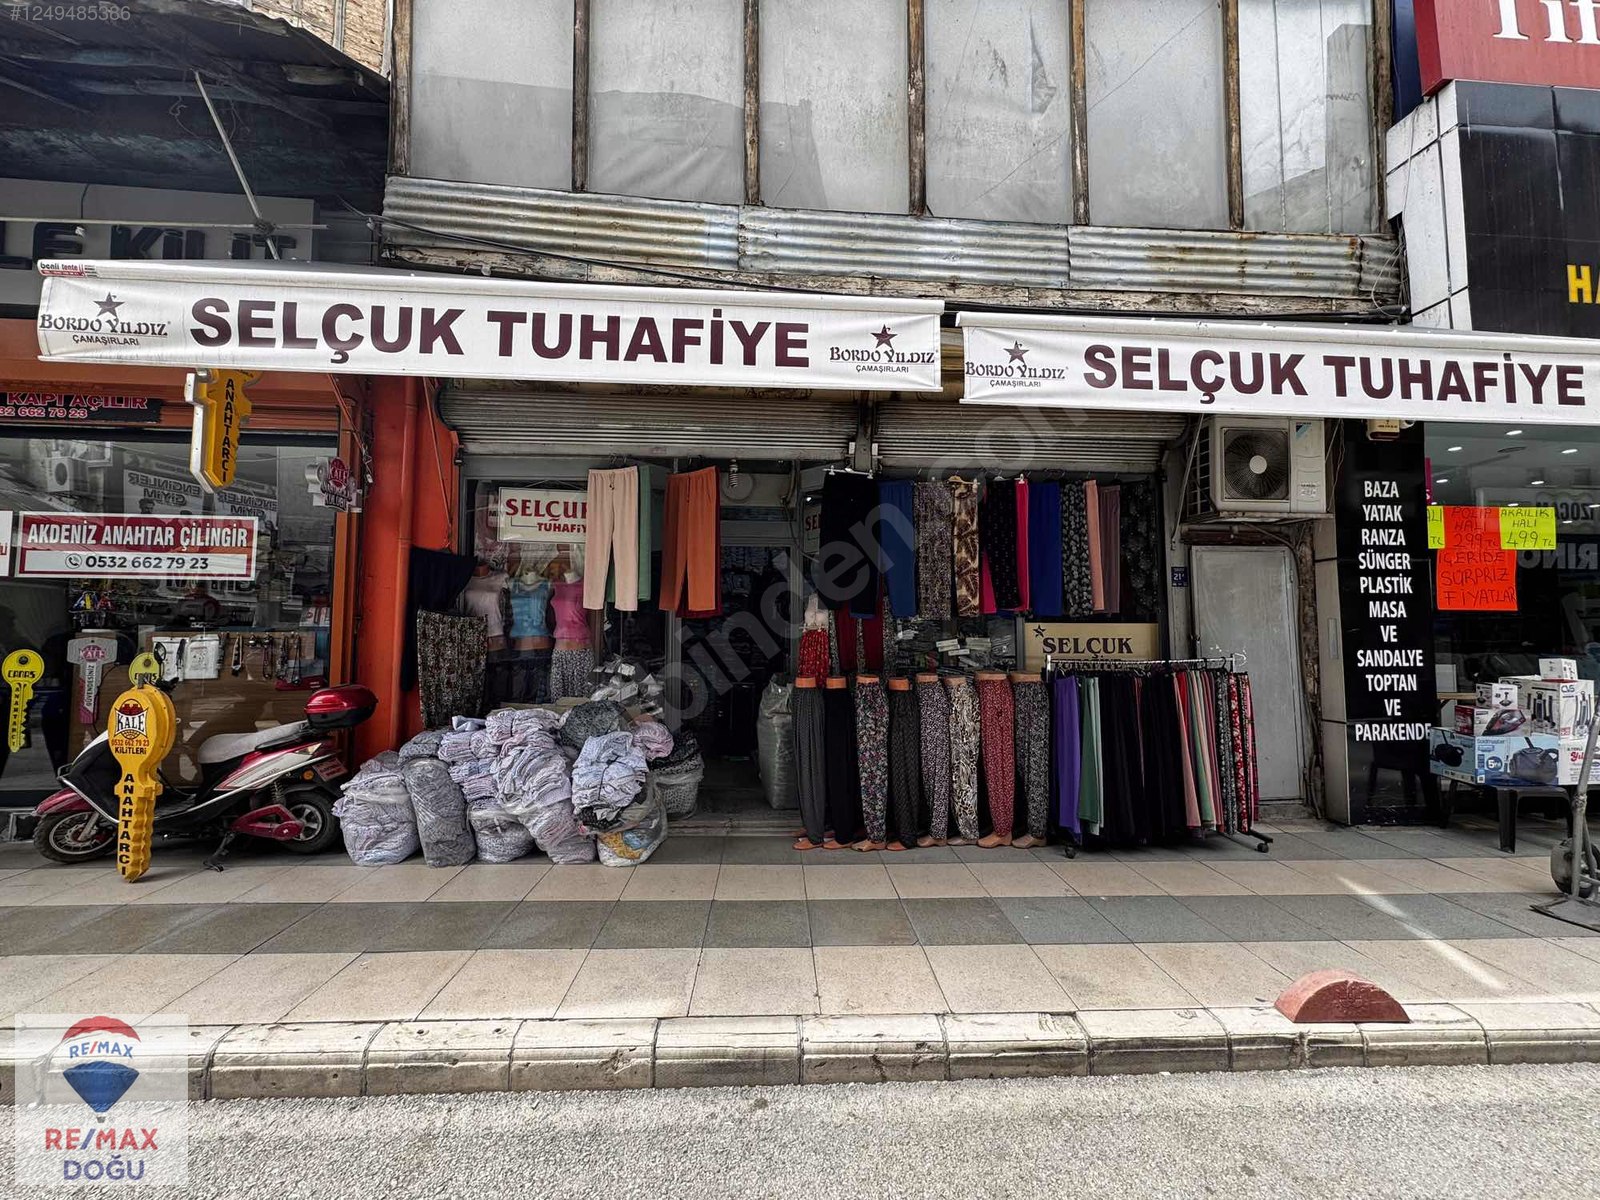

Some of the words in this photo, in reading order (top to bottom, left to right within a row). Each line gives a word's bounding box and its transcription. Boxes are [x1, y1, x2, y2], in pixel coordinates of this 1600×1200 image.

[1567, 264, 1600, 304] H
[40, 314, 102, 332] BORDO
[106, 318, 168, 336] YILDIZ
[190, 298, 466, 364] SELÇUK
[487, 308, 810, 369] TUHAFİYE
[73, 334, 139, 346] ÇAMAŞIRLARI
[830, 346, 881, 363] BORDO
[884, 349, 935, 364] YILDIZ
[856, 364, 909, 374] ÇAMAŞIRLARI
[965, 361, 1014, 377] BORDO
[1016, 364, 1066, 380] YILDIZ
[1083, 344, 1308, 404] SELÇUK
[1324, 352, 1586, 406] TUHAFİYE
[989, 379, 1042, 388] ÇAMAŞIRLARI
[7, 392, 65, 407] KAPI
[69, 394, 148, 411] AÇILIR
[18, 406, 45, 417] 662
[48, 407, 67, 418] 79
[69, 408, 88, 419] 23
[221, 378, 235, 482] ANAHTARCI
[1364, 481, 1399, 498] BAZA
[1362, 505, 1403, 522] YATAK
[1512, 519, 1537, 528] HALI
[28, 520, 96, 545] AKDENİZ
[102, 525, 174, 546] ANAHTAR
[180, 522, 248, 552] ÇİLİNGİR
[1361, 529, 1406, 546] RANZA
[1506, 530, 1539, 548] 499
[1542, 538, 1555, 547] TL
[85, 556, 127, 569] 0532
[131, 557, 162, 569] 662
[166, 557, 185, 570] 79
[189, 557, 209, 570] 23
[1358, 549, 1411, 570] SÜNGER
[1360, 573, 1413, 594] PLASTİK
[1369, 601, 1407, 618] MASA
[1380, 626, 1398, 643] VE
[1043, 637, 1133, 659] SELÇUK
[1357, 649, 1423, 667] SANDALYE
[1366, 674, 1417, 691] TOPTAN
[1384, 698, 1402, 716] VE
[117, 713, 146, 733] KALE
[1355, 723, 1431, 741] PARAKENDE
[111, 738, 124, 747] 0532
[125, 739, 134, 747] 662
[135, 739, 142, 747] 79
[143, 739, 150, 747] 23
[114, 746, 147, 755] KİLİTLERİ
[118, 773, 135, 876] ANAHTARCI
